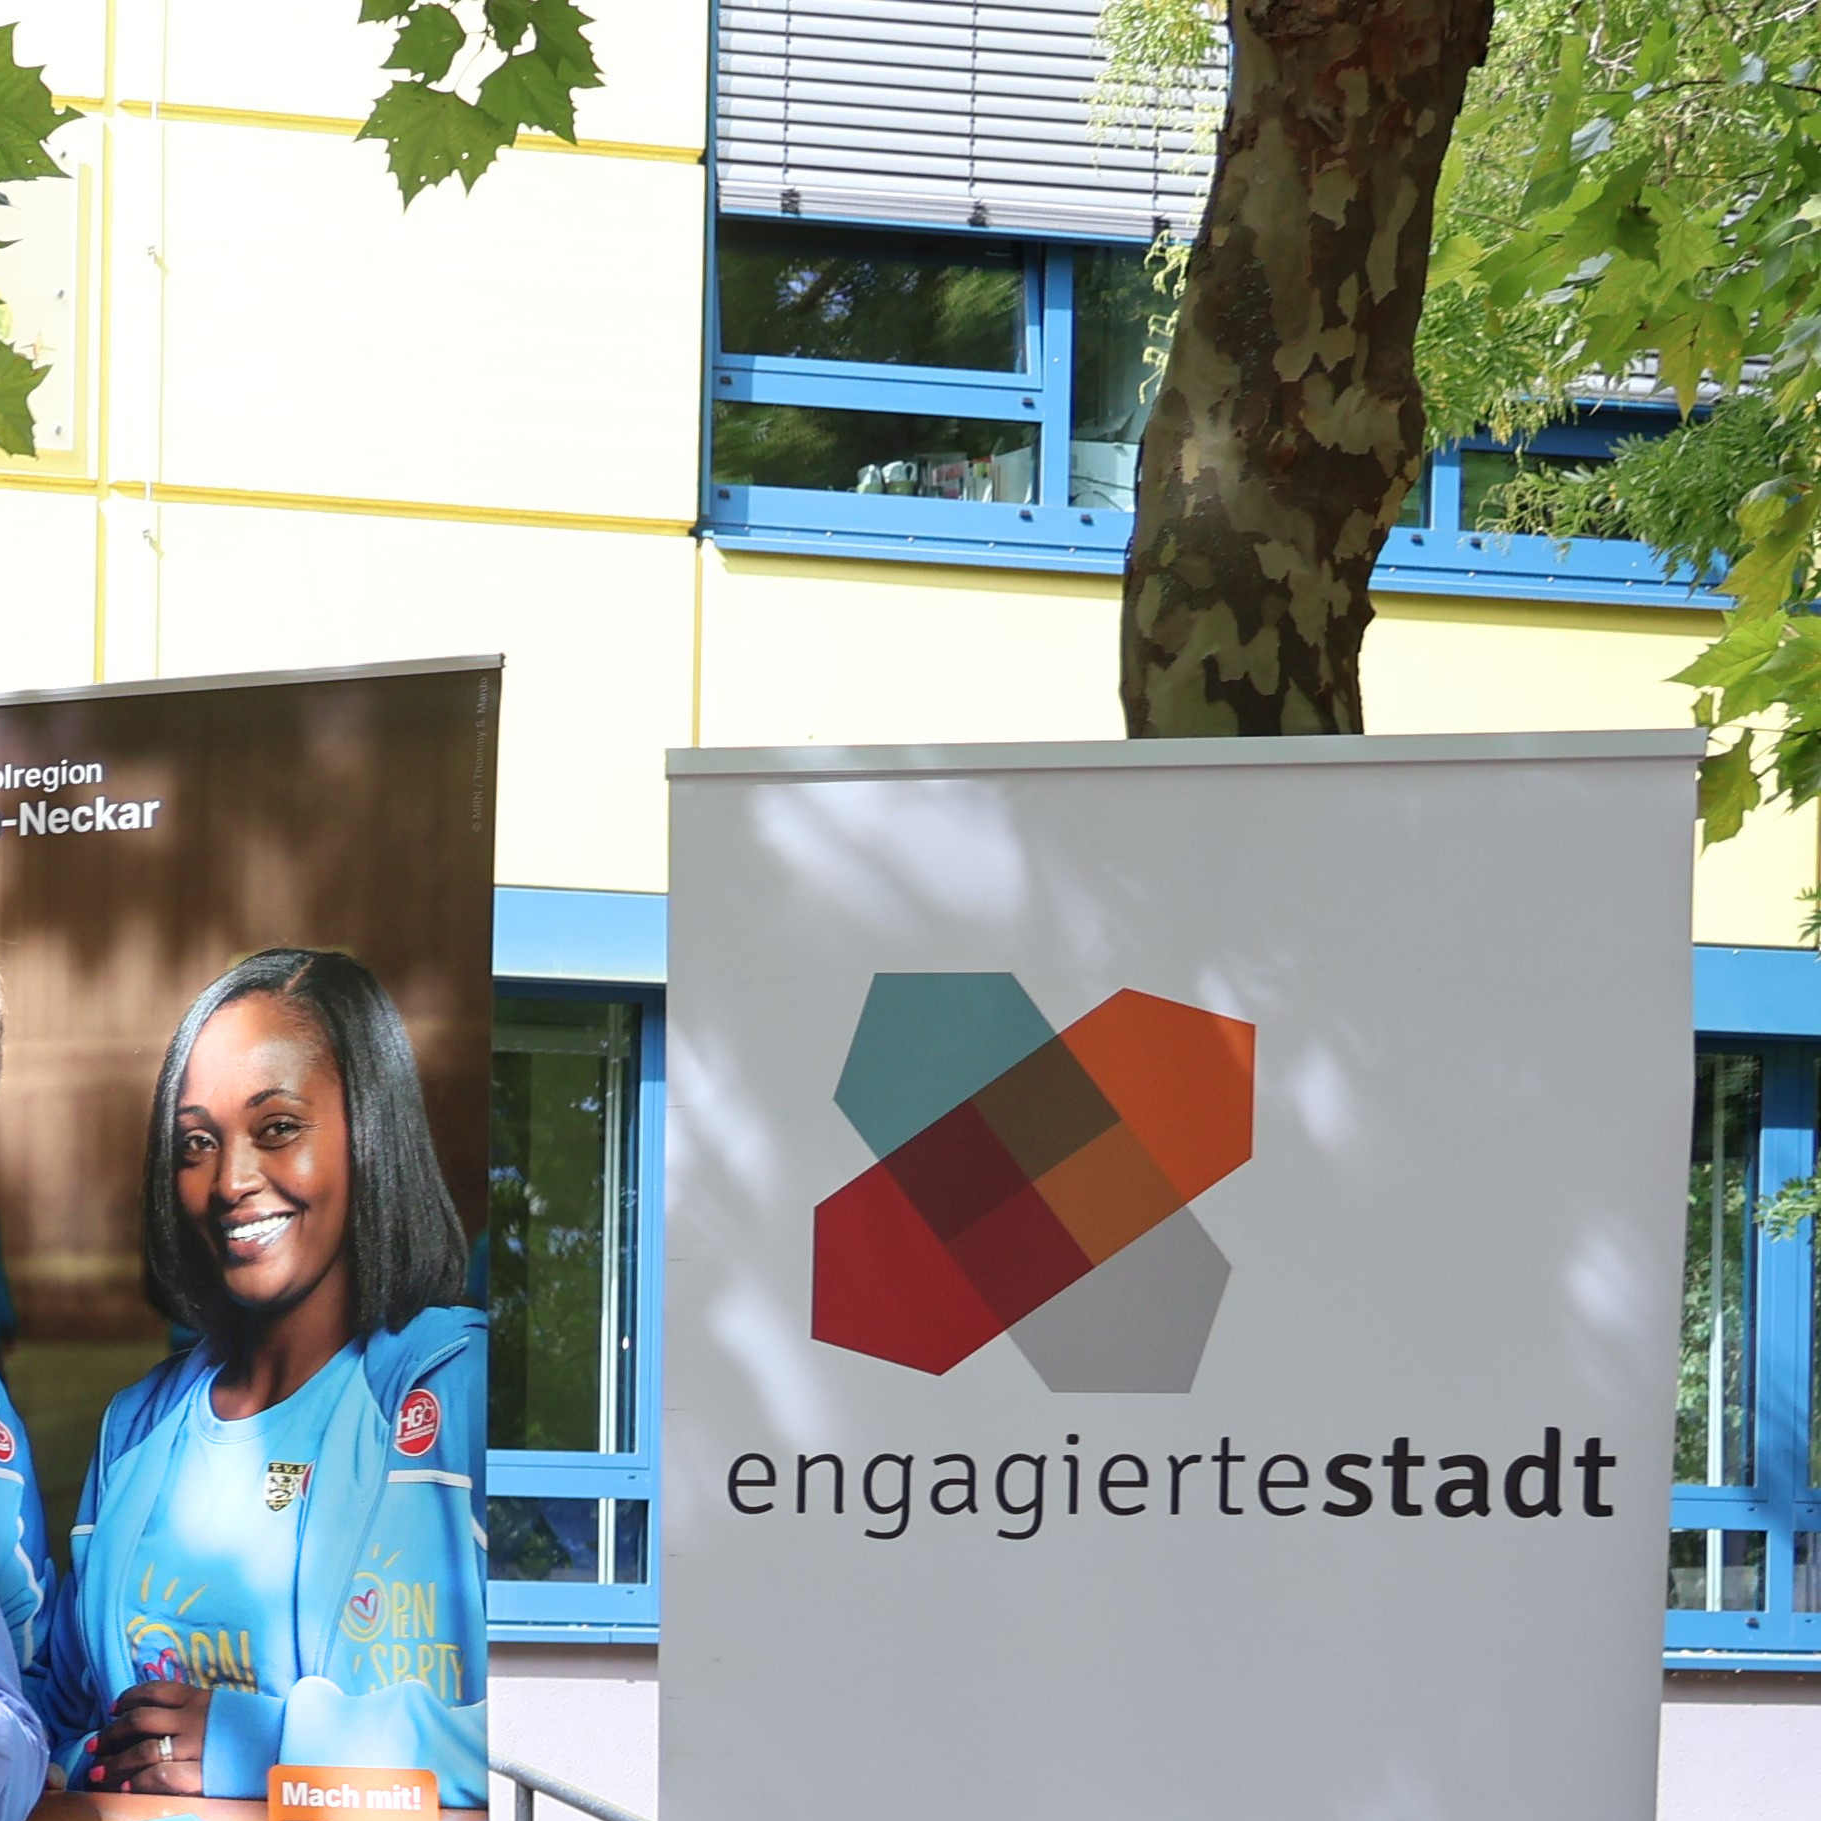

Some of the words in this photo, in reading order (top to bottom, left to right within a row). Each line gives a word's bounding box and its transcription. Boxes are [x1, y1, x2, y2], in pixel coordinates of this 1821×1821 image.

[726, 1425, 1617, 1540] engagiertestadt
[281, 1782, 358, 1808] Mach
[365, 1783, 421, 1811] mit!
